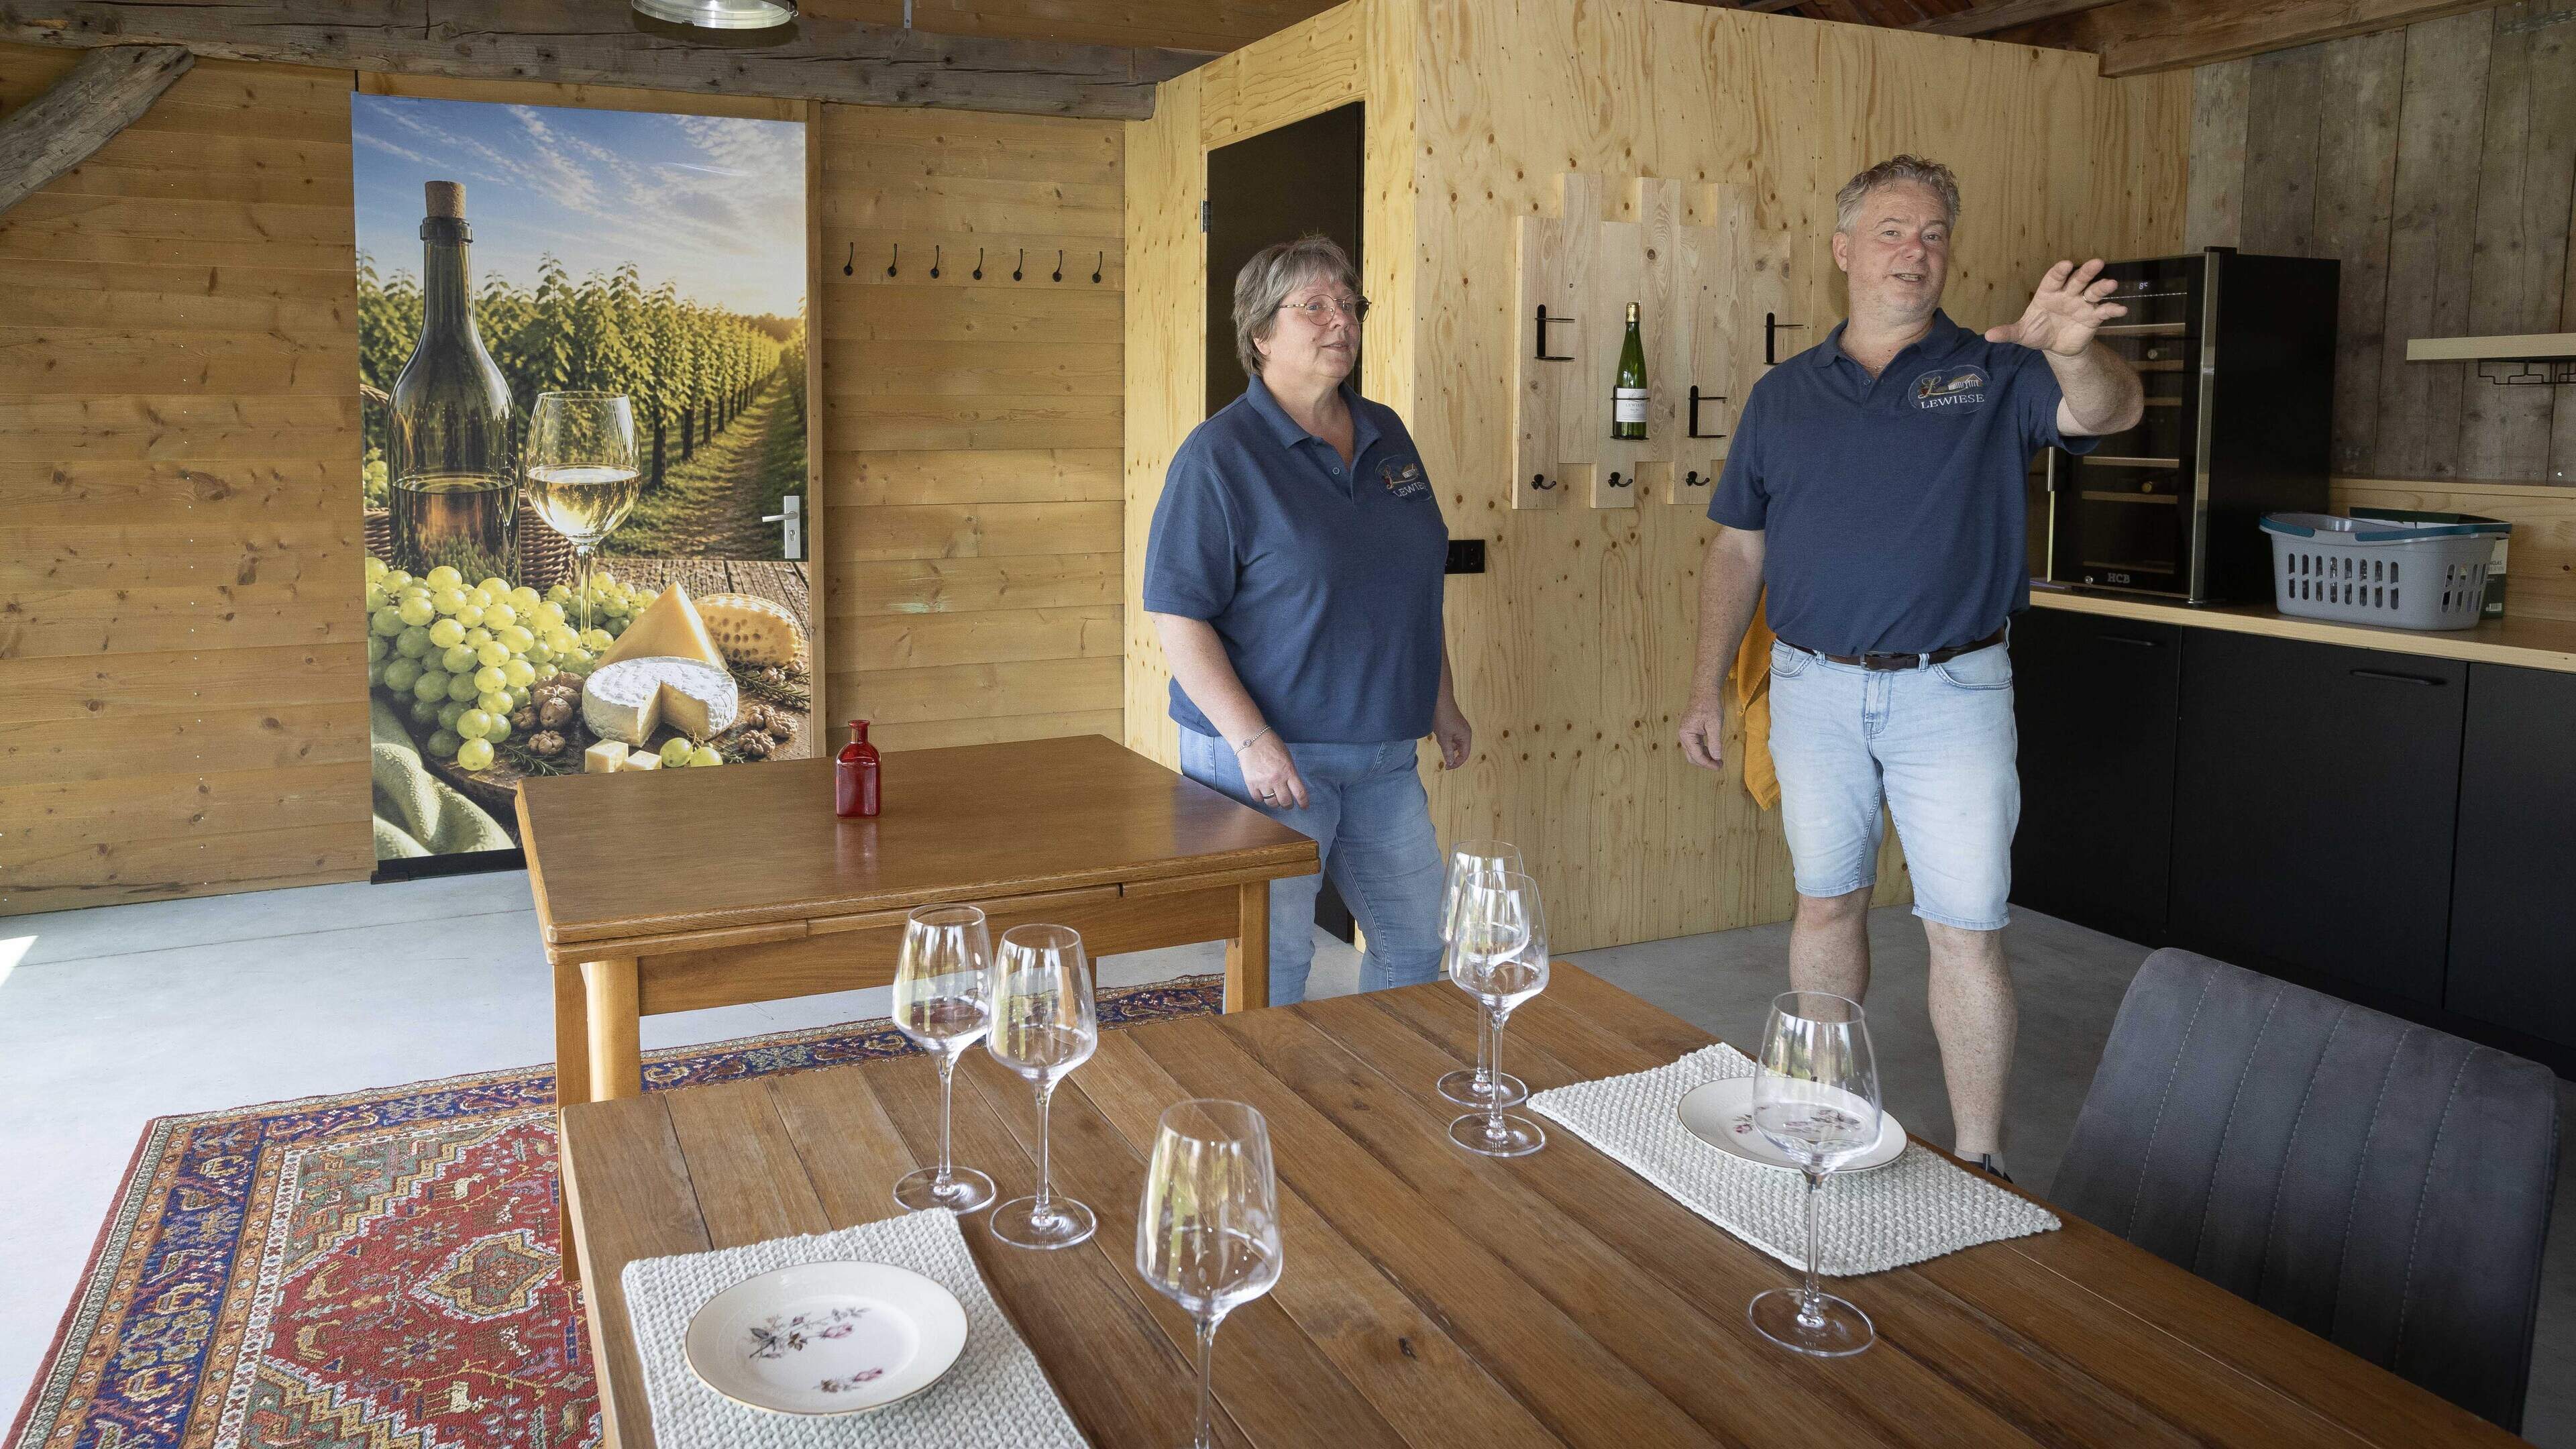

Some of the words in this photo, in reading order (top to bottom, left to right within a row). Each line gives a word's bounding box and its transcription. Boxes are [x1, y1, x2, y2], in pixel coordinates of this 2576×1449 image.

[1921, 394, 1985, 409] LEWIESE
[1393, 482, 1428, 497] LEWIE
[2107, 572, 2131, 584] HCB
